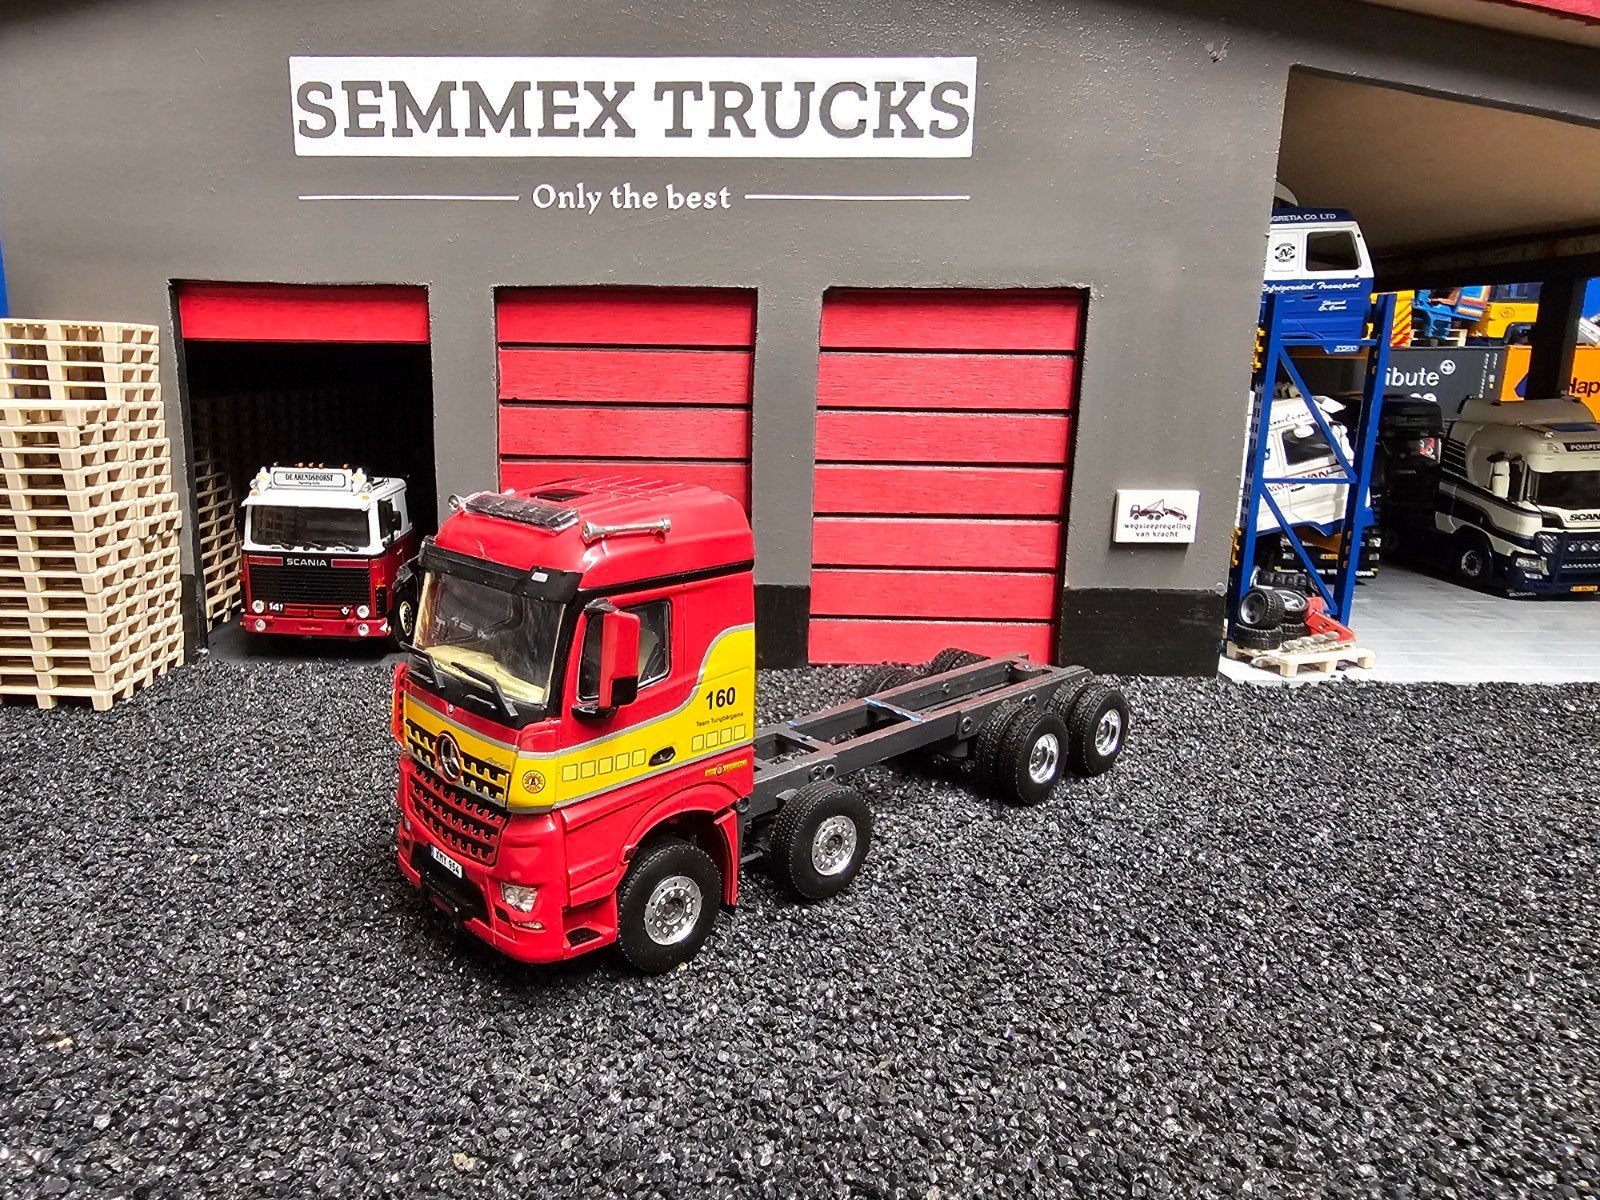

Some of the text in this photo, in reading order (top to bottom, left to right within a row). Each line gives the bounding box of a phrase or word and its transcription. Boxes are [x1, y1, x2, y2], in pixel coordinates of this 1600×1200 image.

[296, 80, 970, 139] SEMMEX TRUCKS
[532, 182, 732, 214] Only the best
[1317, 281, 1361, 291] Transport
[286, 558, 328, 567] SCANIA
[268, 601, 284, 612] 141
[705, 686, 736, 710] 160
[696, 718, 710, 728] Team
